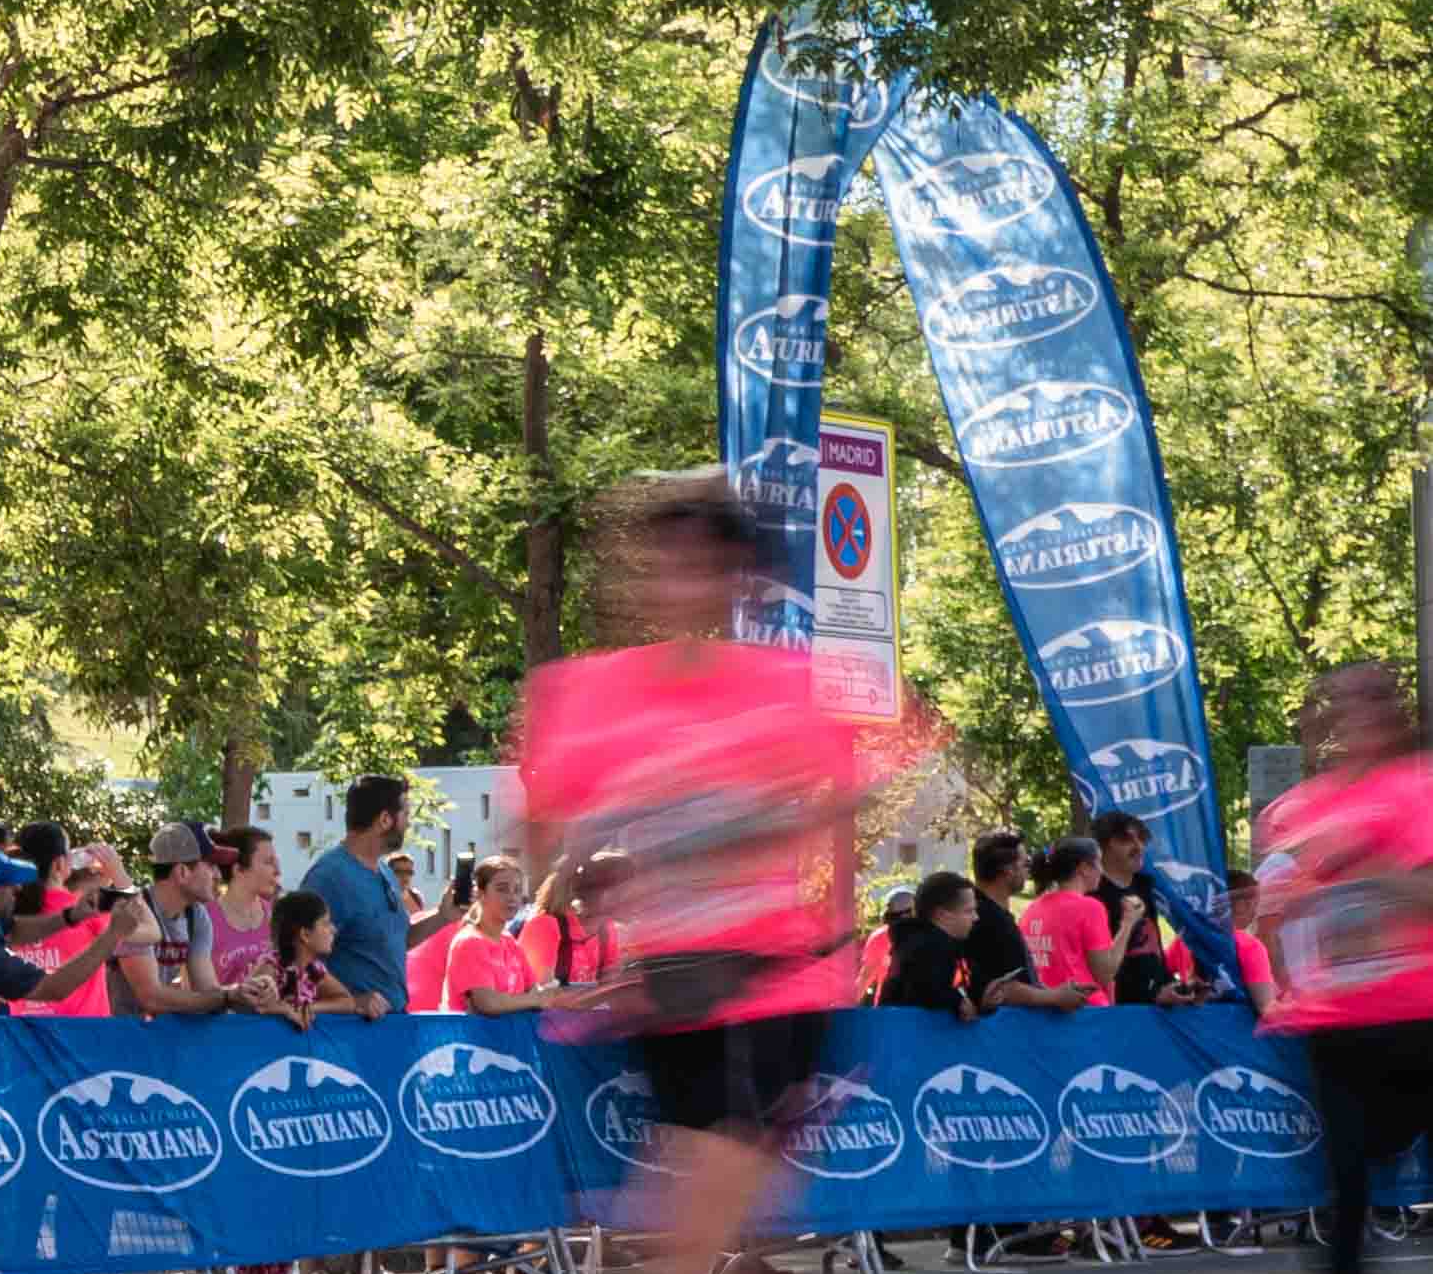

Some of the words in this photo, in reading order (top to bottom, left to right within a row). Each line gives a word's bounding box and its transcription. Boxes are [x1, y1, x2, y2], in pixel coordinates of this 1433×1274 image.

[828, 440, 877, 468] MADRID
[248, 1105, 384, 1152] ASTURIANA
[414, 1085, 546, 1134] ASTURIANA
[924, 1103, 1042, 1143] ASTURIANA
[59, 1113, 214, 1163] ASTURIANA
